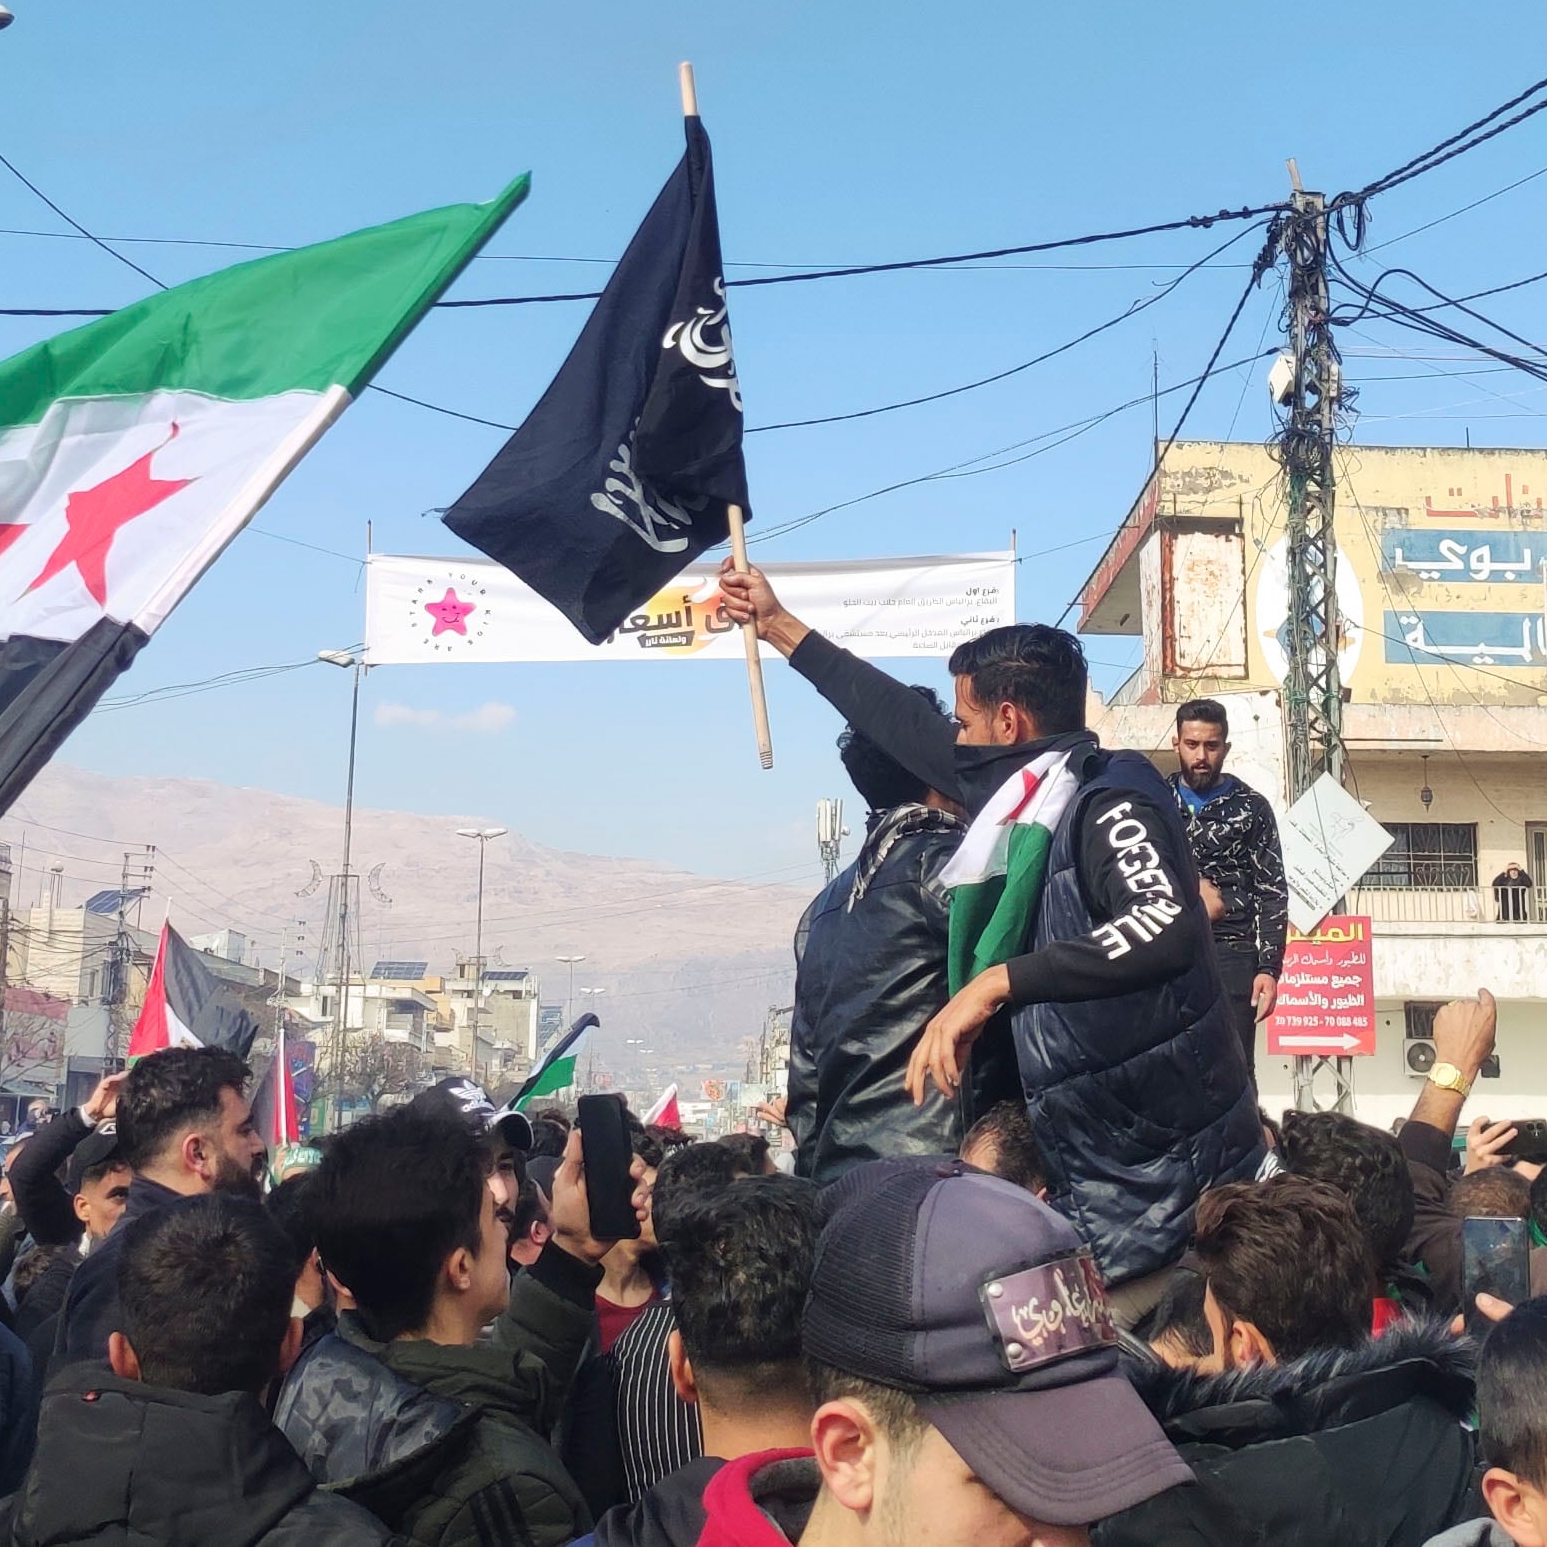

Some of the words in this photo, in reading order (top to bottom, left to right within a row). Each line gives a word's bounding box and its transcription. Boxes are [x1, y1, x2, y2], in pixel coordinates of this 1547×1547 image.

[1395, 538, 1532, 581] بوي
[1330, 973, 1363, 989] جميع
[1330, 993, 1365, 1010] الطيور
[1303, 1016, 1319, 1026] 925
[1324, 1016, 1335, 1026] 70
